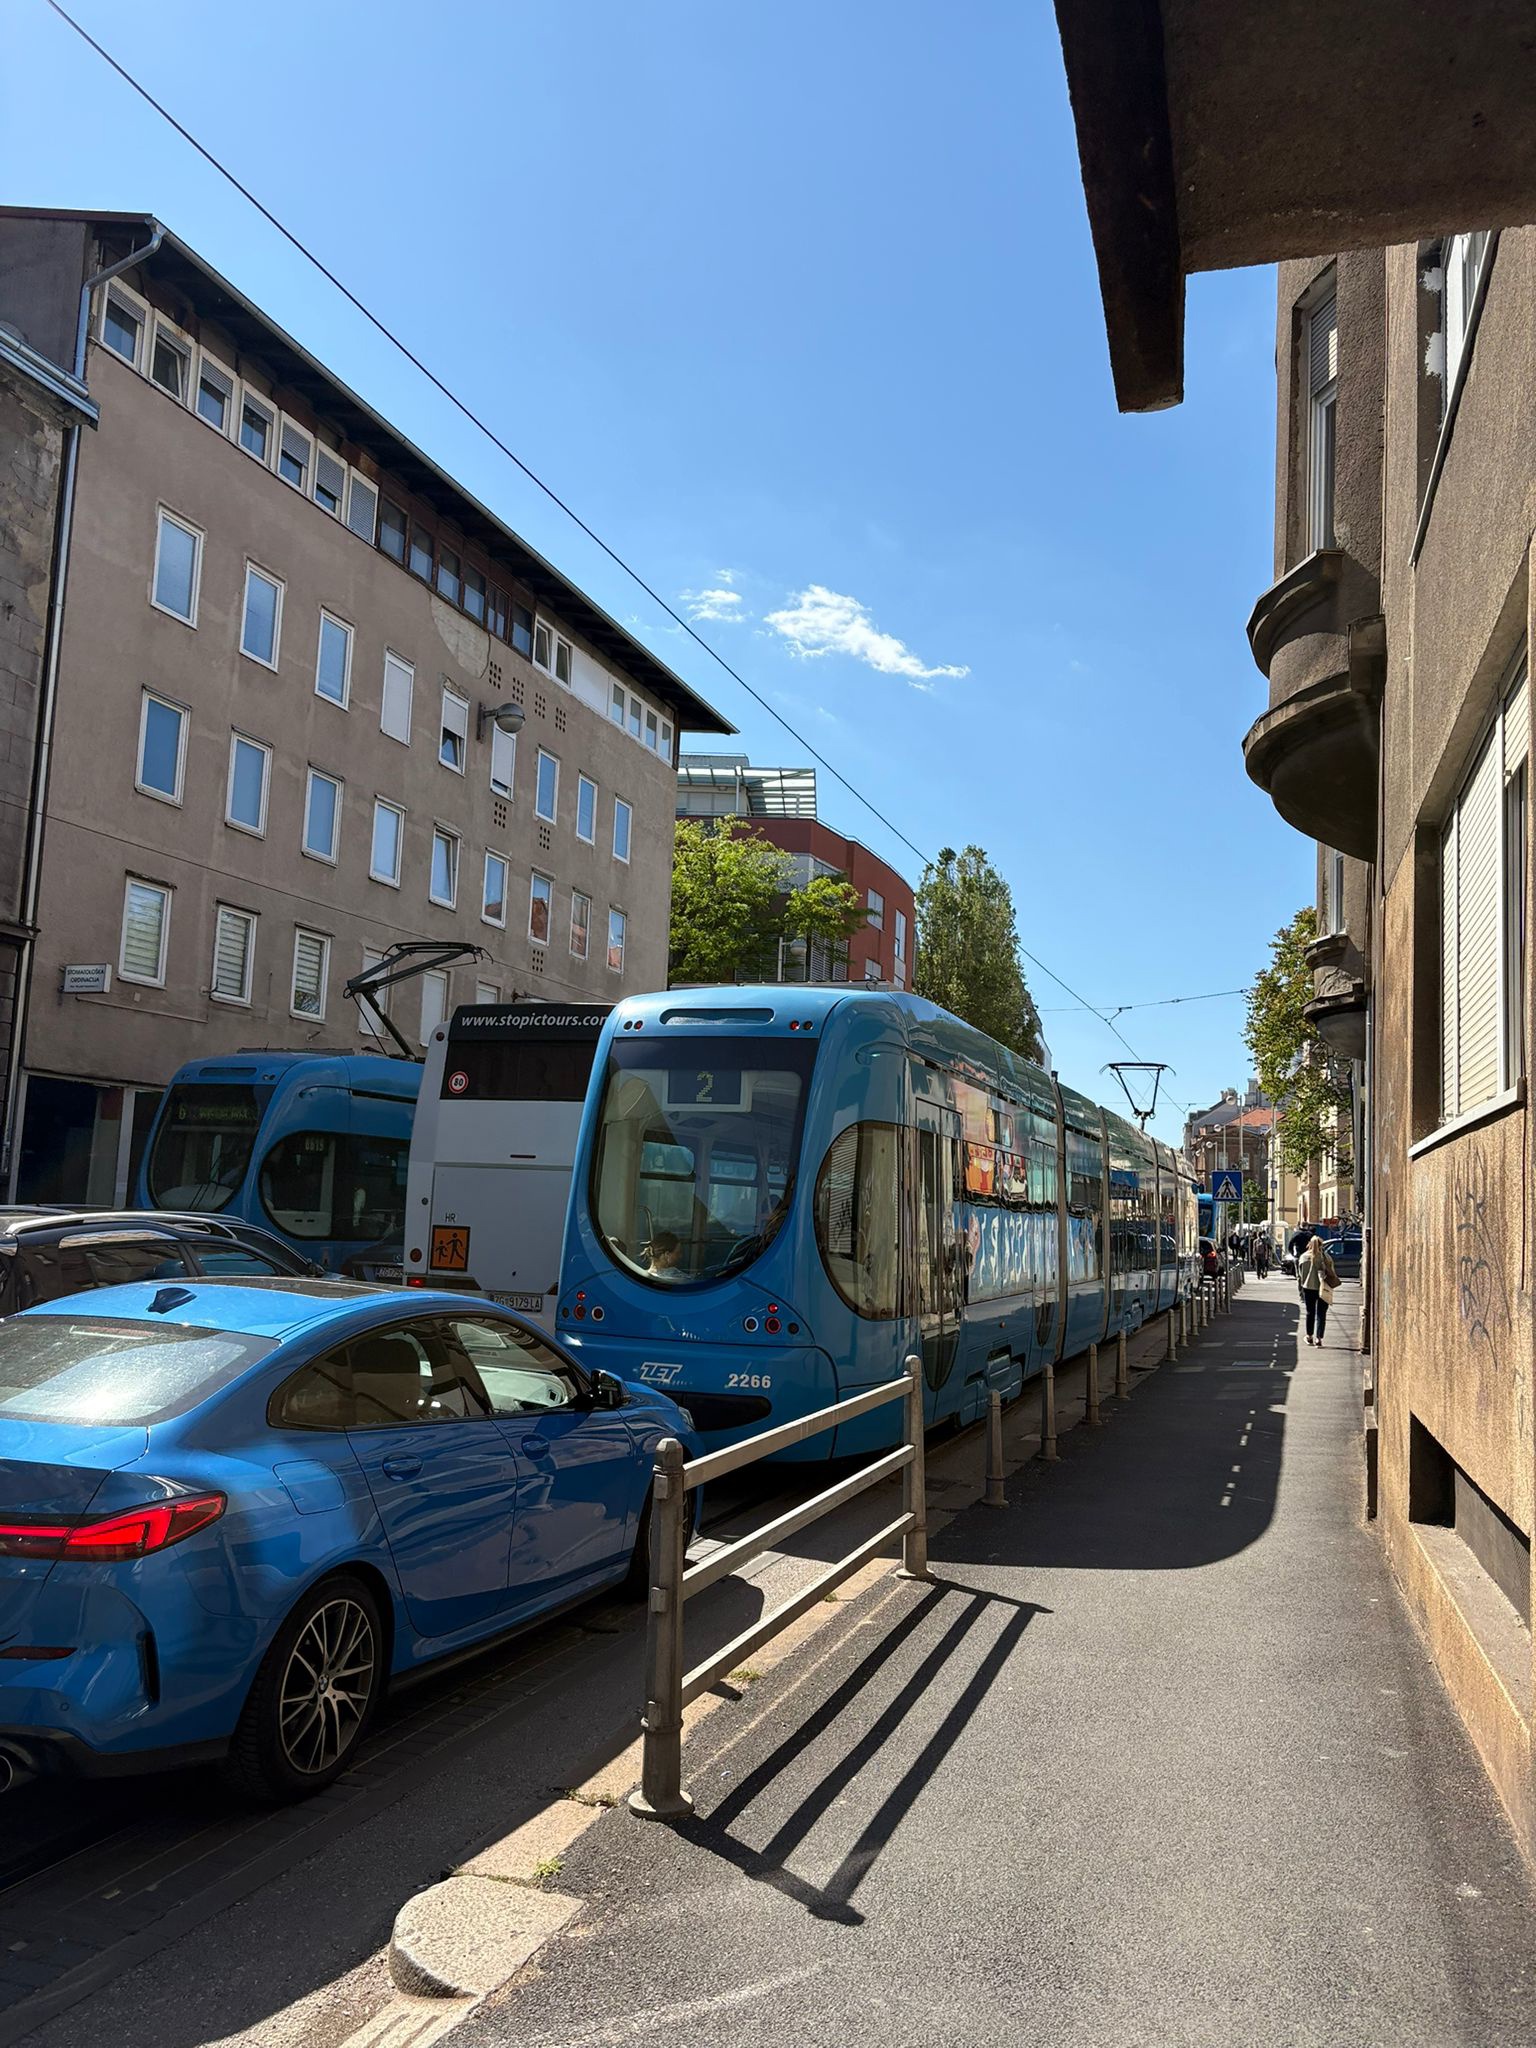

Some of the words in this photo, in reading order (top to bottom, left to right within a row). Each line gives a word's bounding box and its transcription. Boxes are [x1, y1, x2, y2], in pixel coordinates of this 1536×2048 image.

[453, 1077, 464, 1087] 80
[696, 1071, 714, 1102] 2
[445, 1212, 456, 1223] HR
[640, 1361, 683, 1383] ZET
[728, 1373, 772, 1389] 2266
